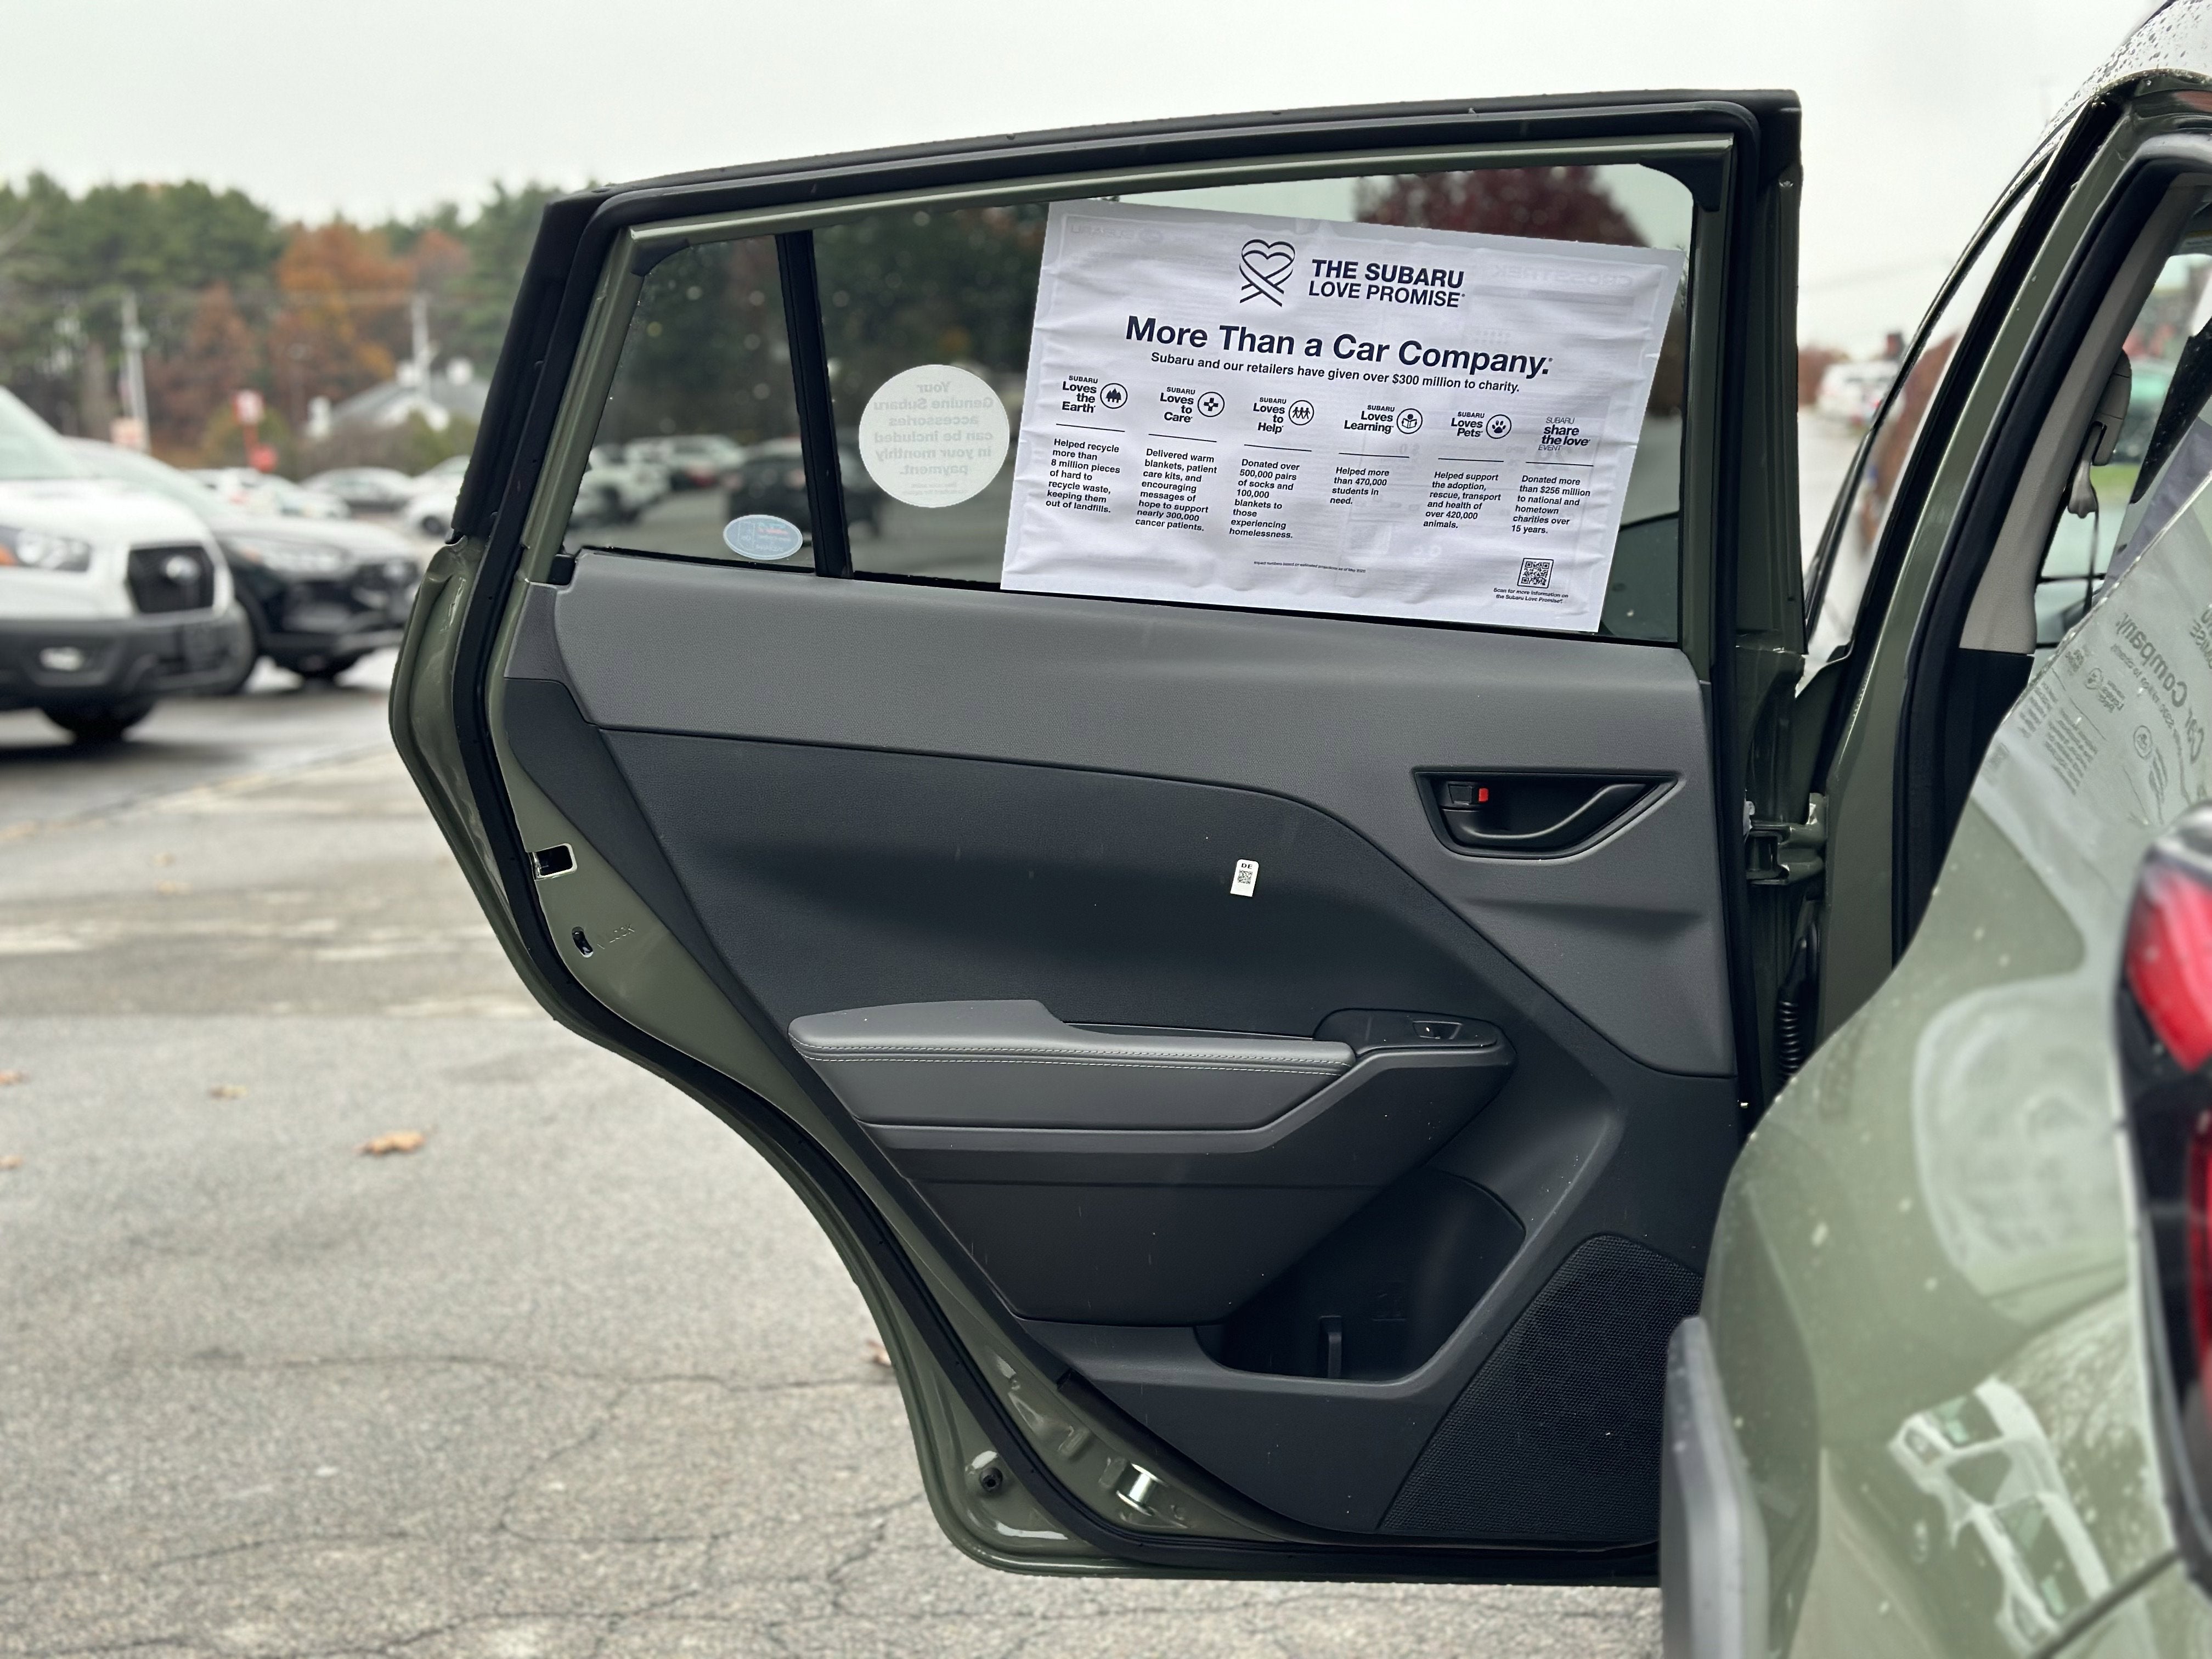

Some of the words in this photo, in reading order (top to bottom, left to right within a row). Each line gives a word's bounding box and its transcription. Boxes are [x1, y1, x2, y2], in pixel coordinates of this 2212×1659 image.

[1312, 259, 1358, 279] THE
[1365, 263, 1464, 288] SUBARU
[1309, 281, 1361, 298] LOVE
[1126, 316, 1207, 347] More
[1220, 325, 1294, 354] Than
[1305, 338, 1322, 357] a
[1334, 334, 1390, 362] Car
[1152, 352, 1194, 365] Subaru
[1198, 360, 1220, 369] and
[1224, 363, 1244, 371] our
[1247, 364, 1293, 375] retailers
[1297, 366, 1324, 377] have
[1328, 369, 1359, 380] given
[1363, 374, 1389, 382] over
[1392, 374, 1419, 385] $300
[1423, 376, 1460, 387] million
[1465, 380, 1475, 388] to
[1479, 380, 1519, 394] charity.
[1063, 381, 1096, 393] Loves
[1076, 393, 1095, 403] the
[1160, 393, 1194, 404] Loves
[1181, 405, 1192, 414] to
[1253, 403, 1285, 414] Loves
[1273, 415, 1283, 423] to
[1361, 411, 1393, 422] Loves
[1451, 418, 1483, 428] Loves
[1544, 425, 1579, 436] share
[1054, 439, 1085, 448] Helped
[1542, 435, 1561, 444] the
[1079, 452, 1097, 460] than
[1147, 449, 1188, 460] Delivered
[1059, 460, 1088, 470] million
[1091, 464, 1120, 473] pieces
[1145, 459, 1184, 471] blankets,
[1242, 459, 1278, 469] Donated
[1062, 470, 1081, 479] hard
[1240, 469, 1273, 478] 500,000
[1336, 467, 1366, 476] Helped
[1434, 472, 1464, 480] Helped
[1165, 472, 1182, 481] kits,
[1522, 475, 1557, 483] Donated
[1049, 482, 1080, 490] recycle
[1083, 485, 1110, 494] waste,
[1142, 482, 1196, 493] encouraging
[1447, 482, 1486, 491] adoption,
[1047, 490, 1082, 501] keeping
[1085, 494, 1106, 503] them
[1141, 492, 1184, 501] messages
[1238, 489, 1269, 498] 100,000
[1463, 493, 1501, 501] transport
[1074, 503, 1110, 512] landfills.
[1139, 500, 1160, 509] hope
[1235, 499, 1271, 508] blankets
[1515, 505, 1559, 514] hometown
[1166, 512, 1199, 521] 300,000
[1167, 522, 1204, 531] patients.
[1231, 520, 1286, 530] experiencing
[1229, 527, 1293, 538] homelessness.
